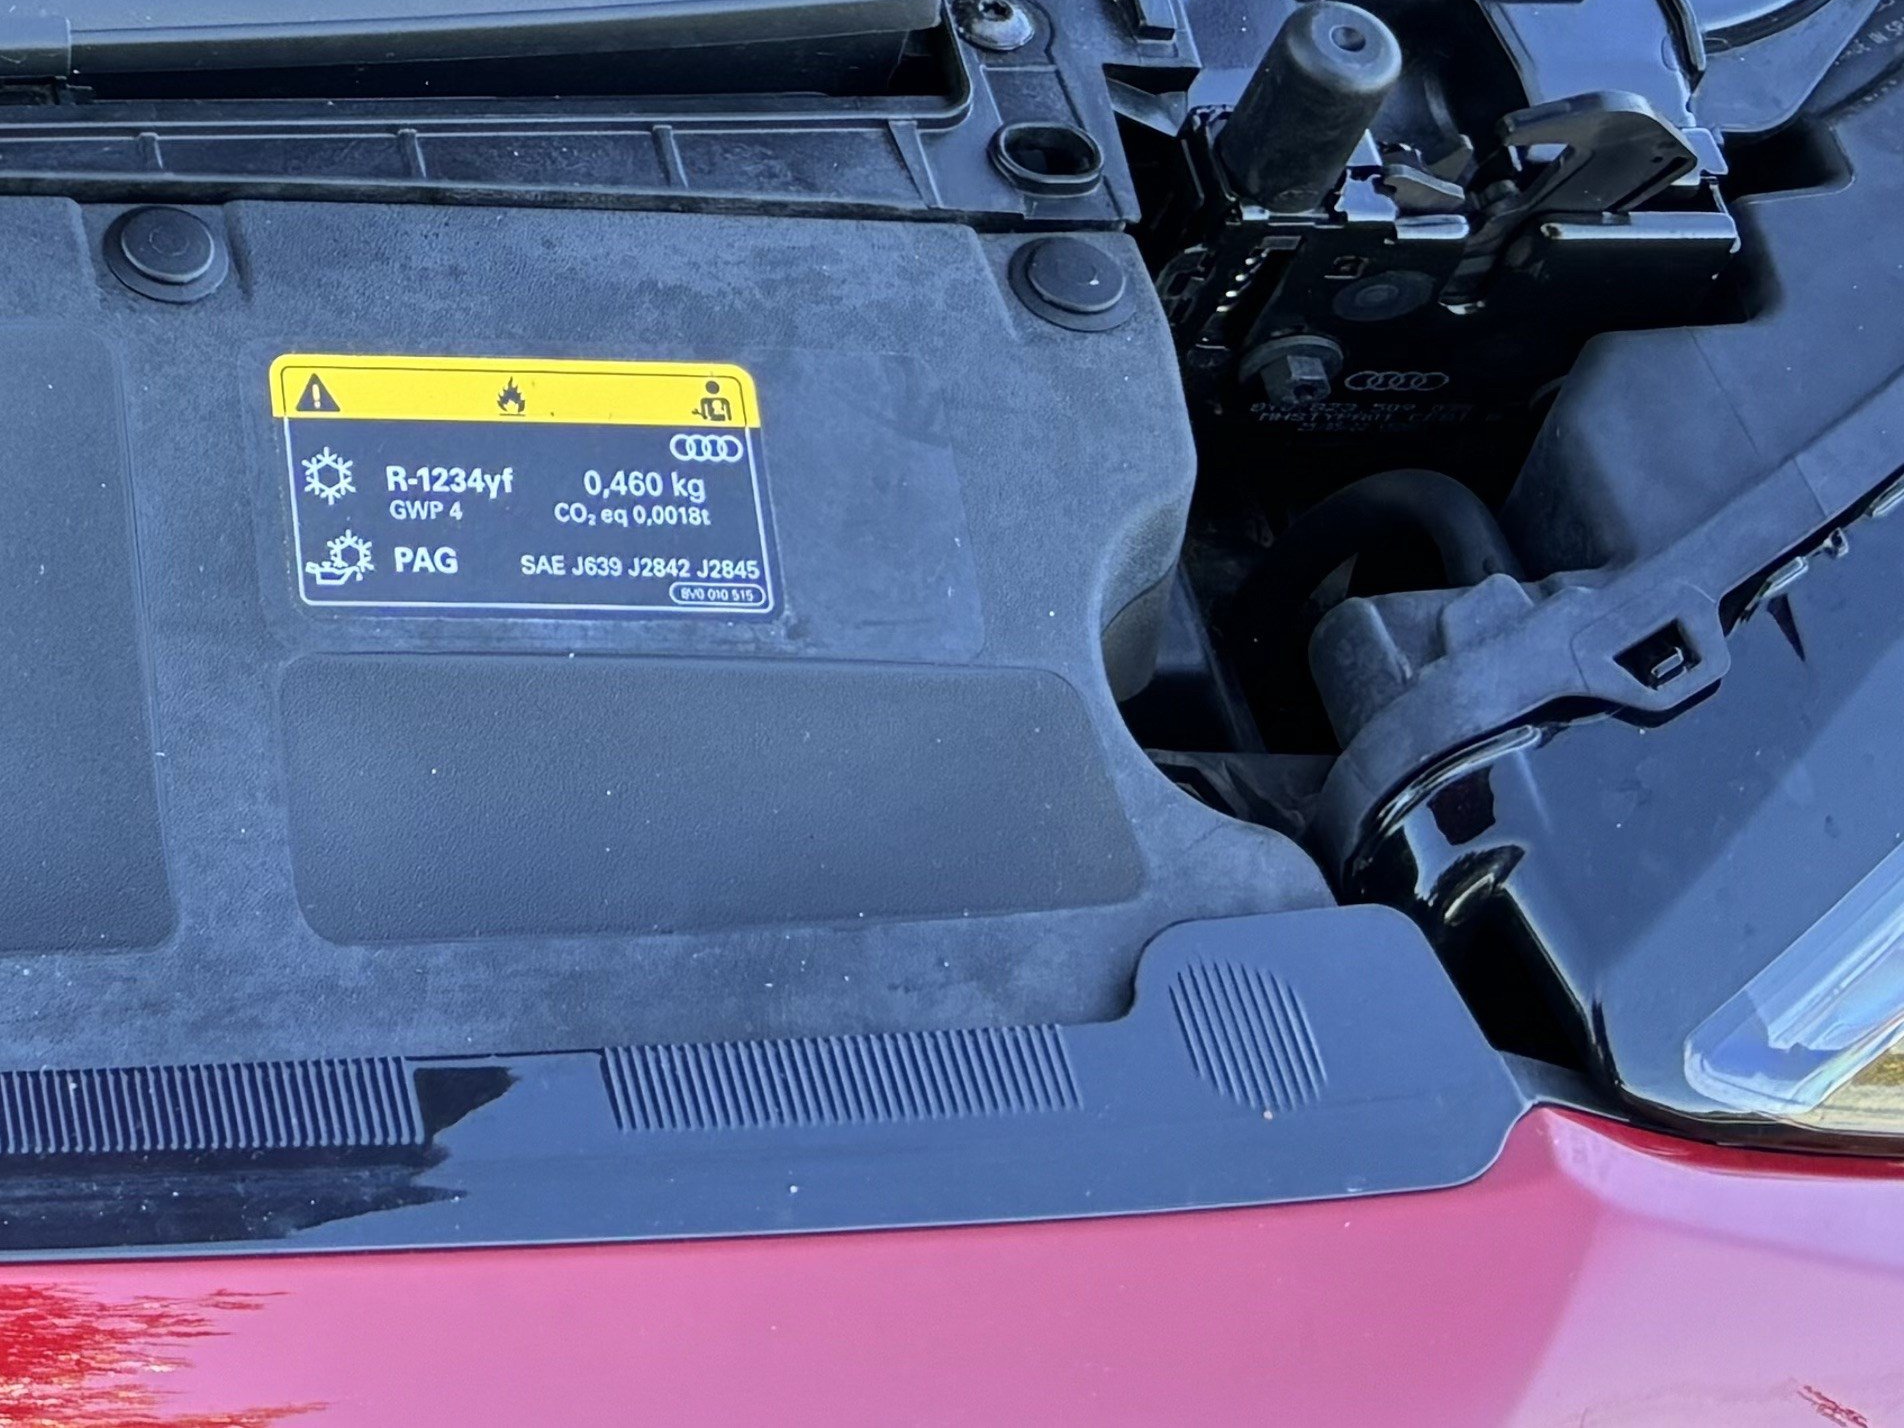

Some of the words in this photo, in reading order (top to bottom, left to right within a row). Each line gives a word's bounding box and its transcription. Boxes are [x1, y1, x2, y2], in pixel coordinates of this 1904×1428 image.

[386, 465, 514, 499] R-1234yf
[583, 470, 664, 499] 0,460
[672, 472, 707, 504] kg
[390, 500, 444, 520] GWP
[449, 501, 463, 520] 4
[601, 508, 628, 527] eq
[632, 505, 711, 526] 0,0018t
[394, 546, 459, 574] PAG
[520, 555, 566, 576] SAE
[571, 556, 623, 577] J639
[628, 557, 691, 578] J2842
[696, 559, 760, 580] J2845
